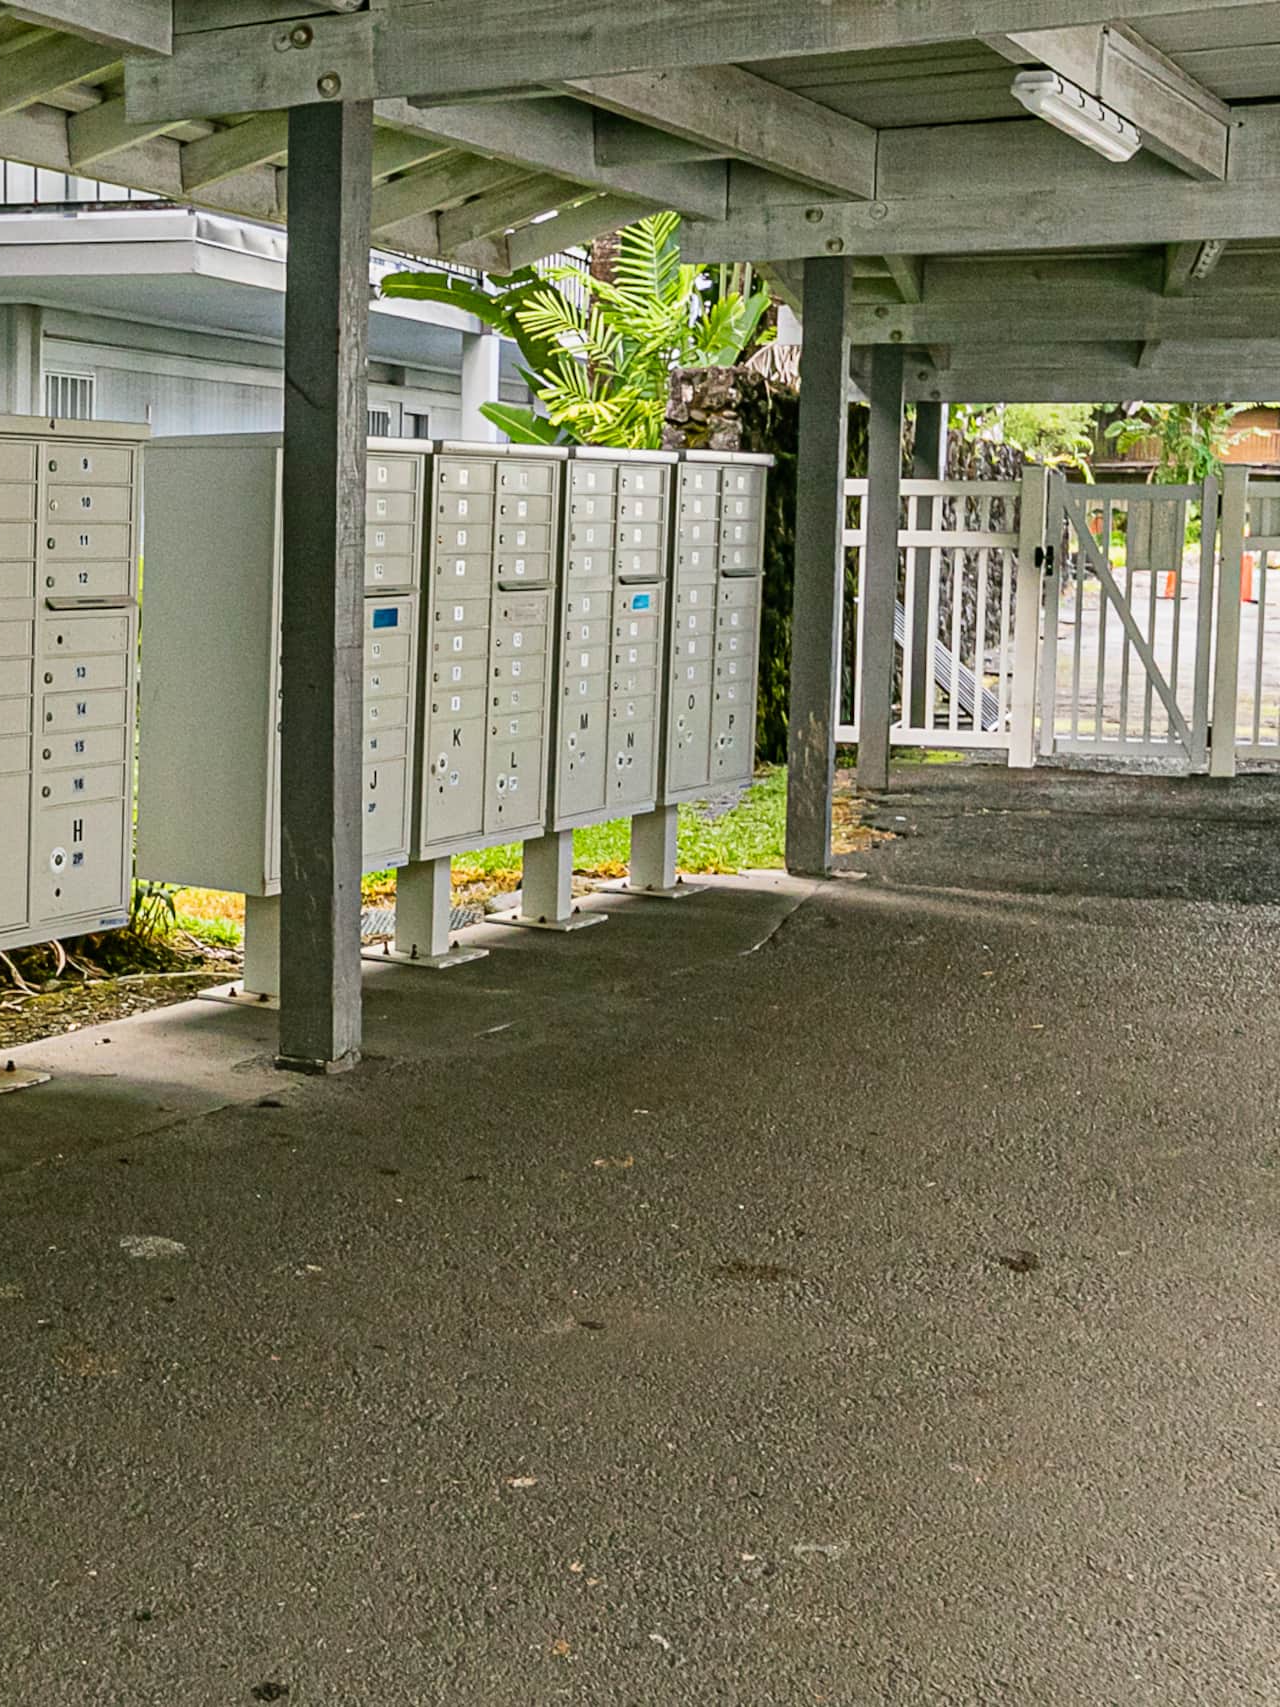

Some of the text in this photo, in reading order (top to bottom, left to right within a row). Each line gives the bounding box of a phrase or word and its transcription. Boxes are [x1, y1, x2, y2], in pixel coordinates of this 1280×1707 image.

[49, 418, 56, 430] 4
[83, 458, 88, 470] 9
[81, 496, 91, 508] 10
[78, 572, 88, 584] 12
[580, 713, 589, 730] M
[728, 714, 735, 729] P
[453, 728, 461, 746] K
[627, 732, 634, 748] N
[511, 751, 518, 769] L
[369, 770, 377, 790] J
[73, 819, 83, 843] H
